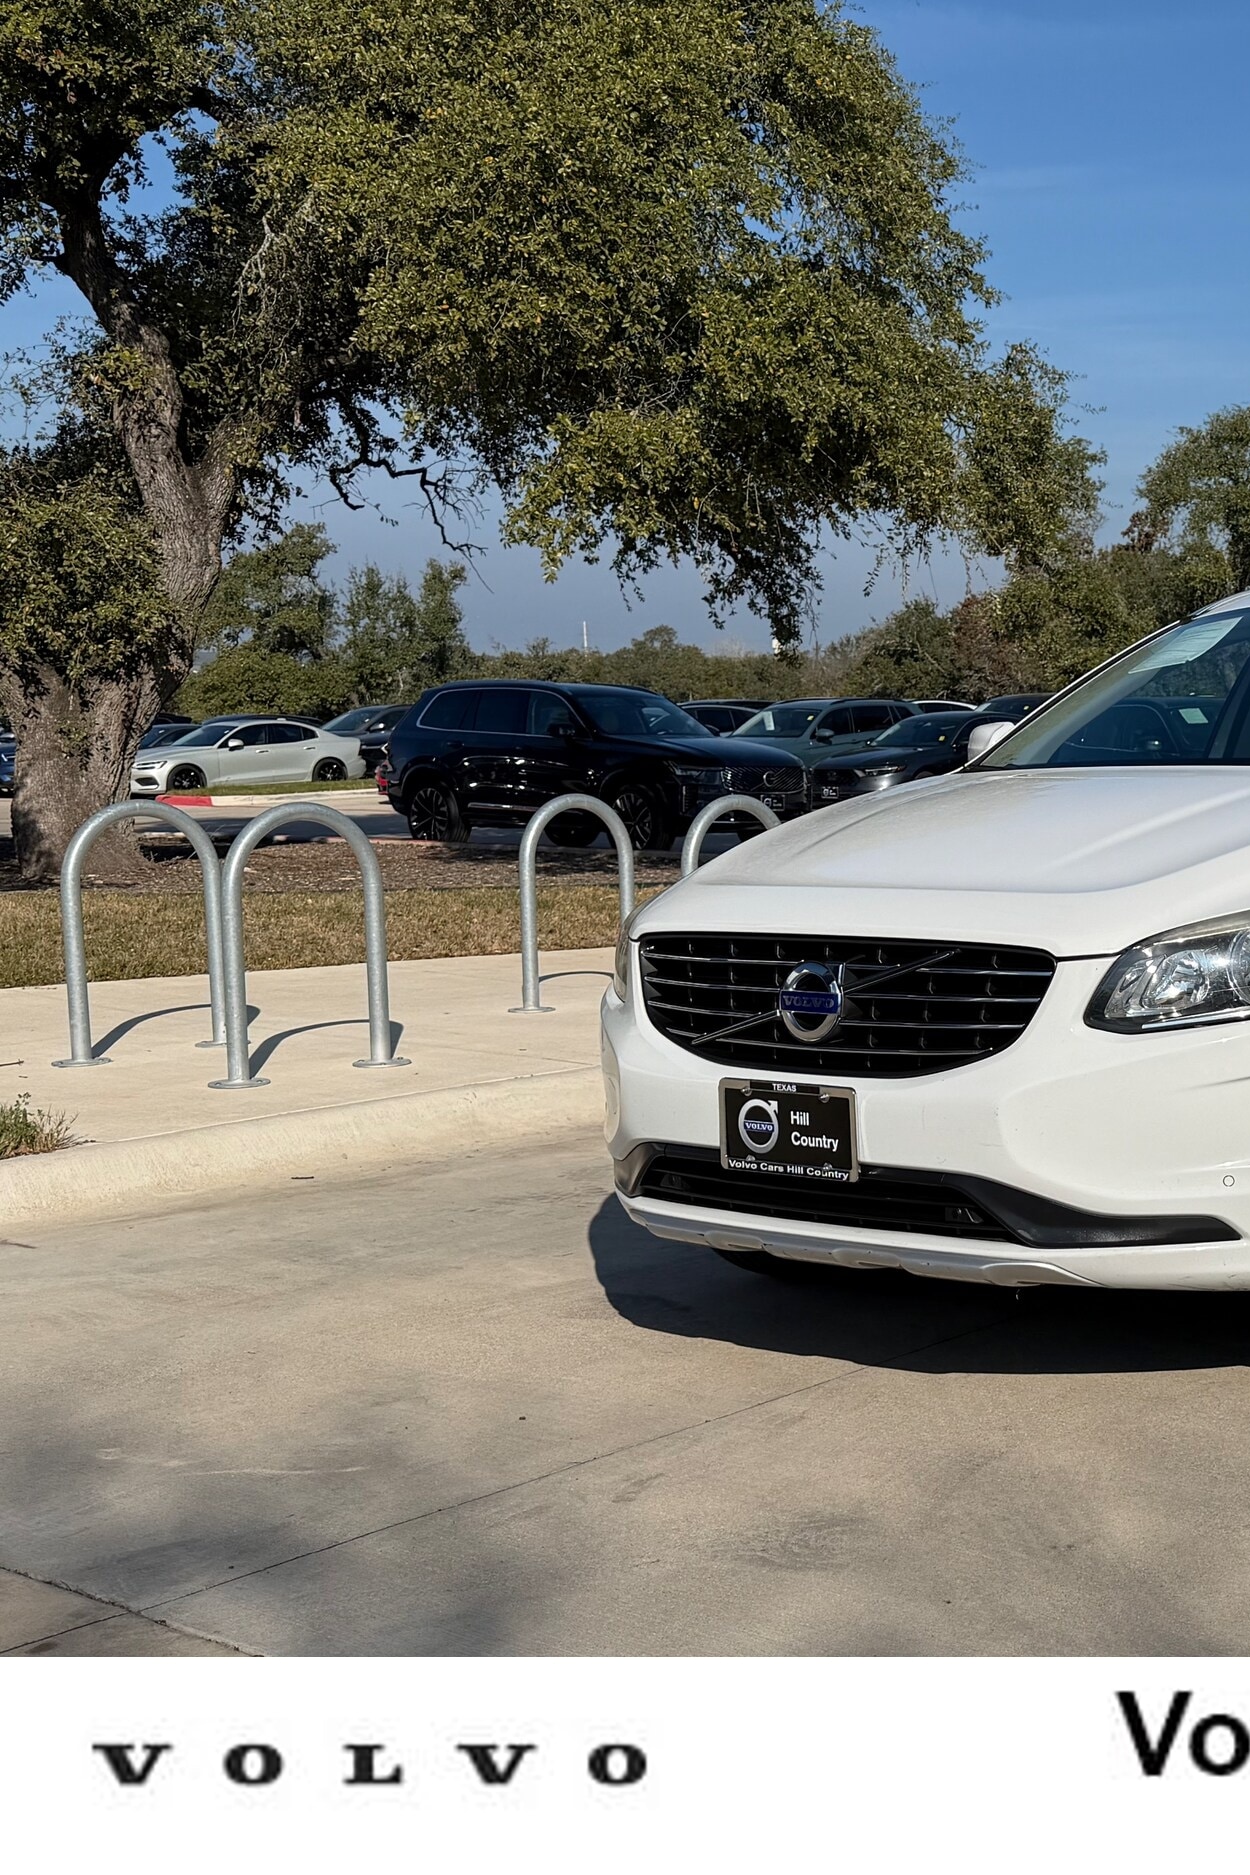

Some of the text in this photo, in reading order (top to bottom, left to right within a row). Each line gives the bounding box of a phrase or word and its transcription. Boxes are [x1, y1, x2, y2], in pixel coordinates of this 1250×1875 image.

[782, 994, 835, 1009] VOLVO
[772, 1083, 797, 1092] TEXAS
[790, 1110, 810, 1126] Hill
[745, 1122, 773, 1131] VOLVO
[790, 1131, 839, 1152] Country
[728, 1159, 849, 1181] Volvo Cars Hill Country
